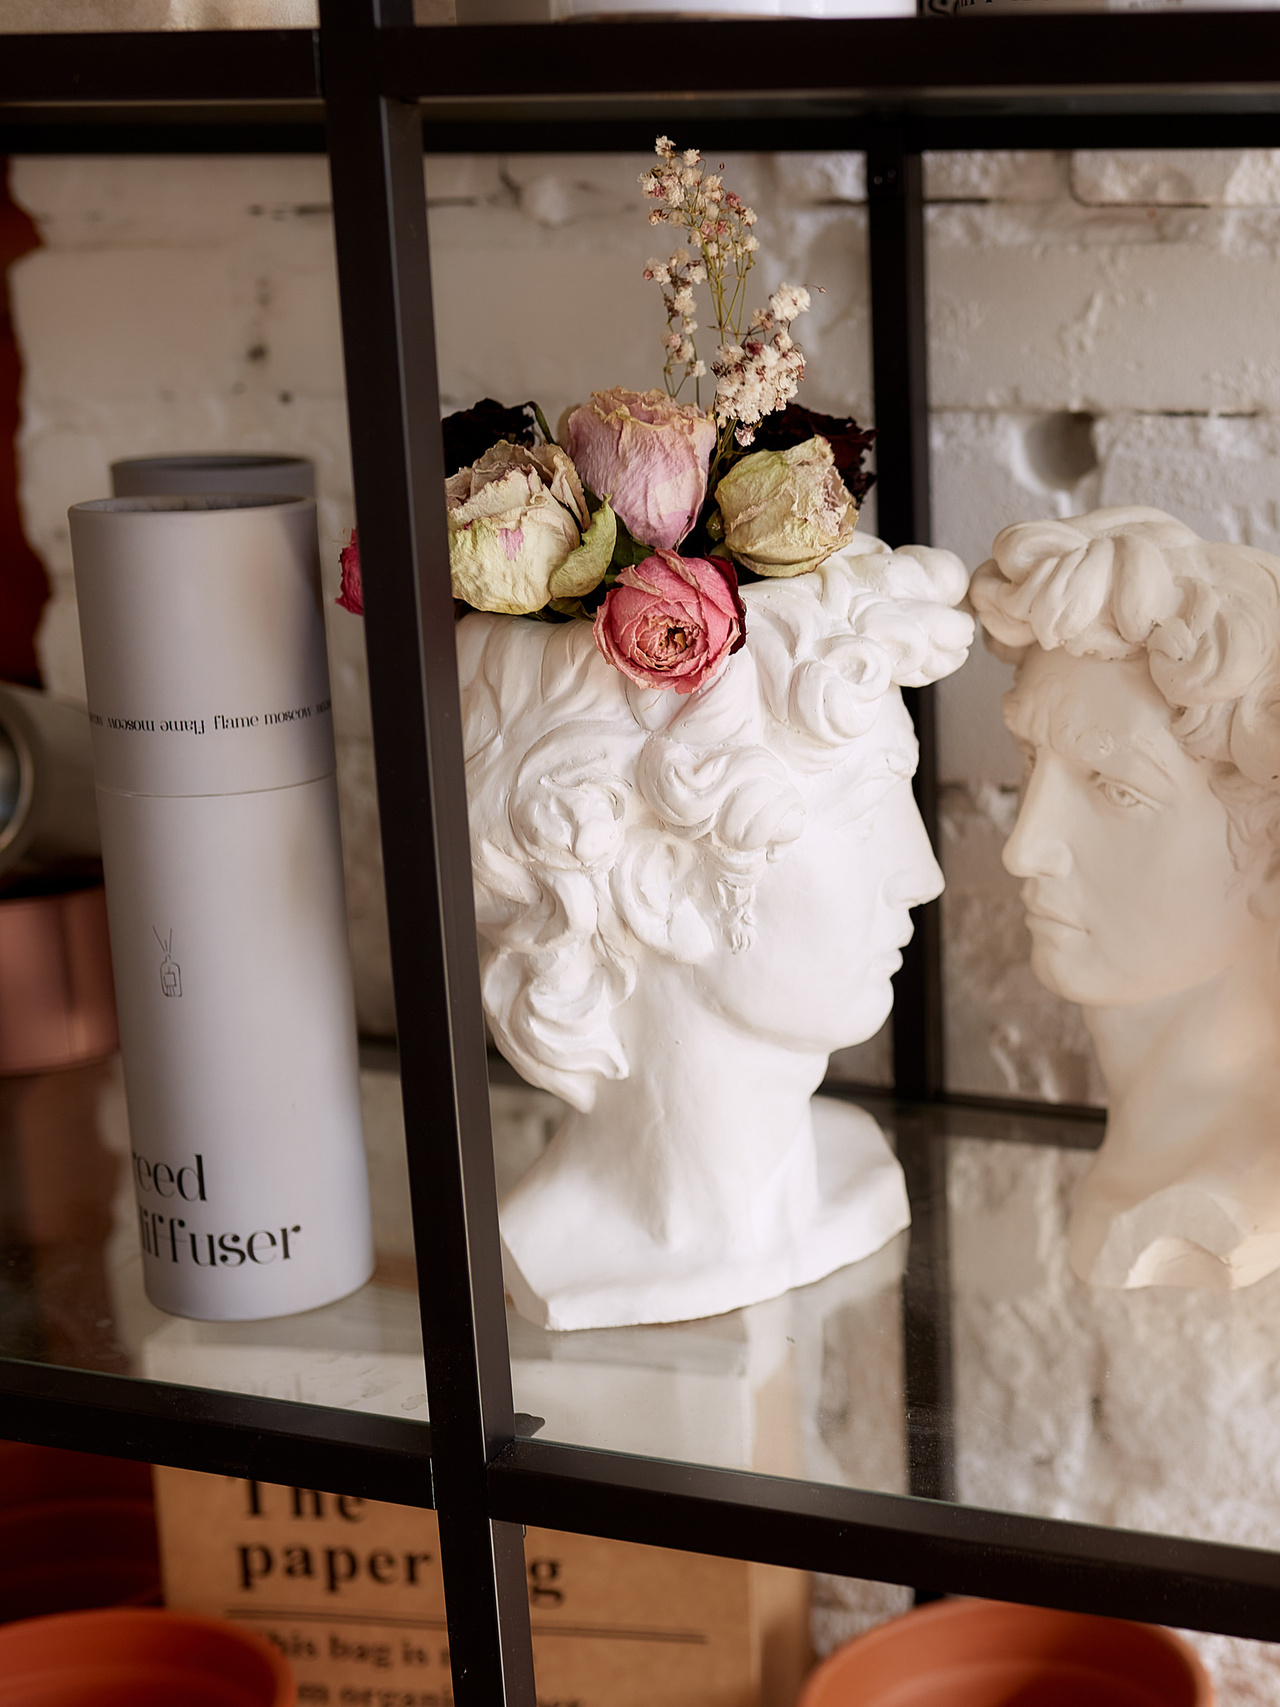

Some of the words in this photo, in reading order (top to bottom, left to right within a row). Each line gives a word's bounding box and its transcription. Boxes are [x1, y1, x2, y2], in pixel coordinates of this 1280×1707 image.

[212, 714, 259, 730] flame
[263, 706, 312, 725] moscow
[238, 1541, 432, 1592] paper
[328, 1629, 395, 1669] bag
